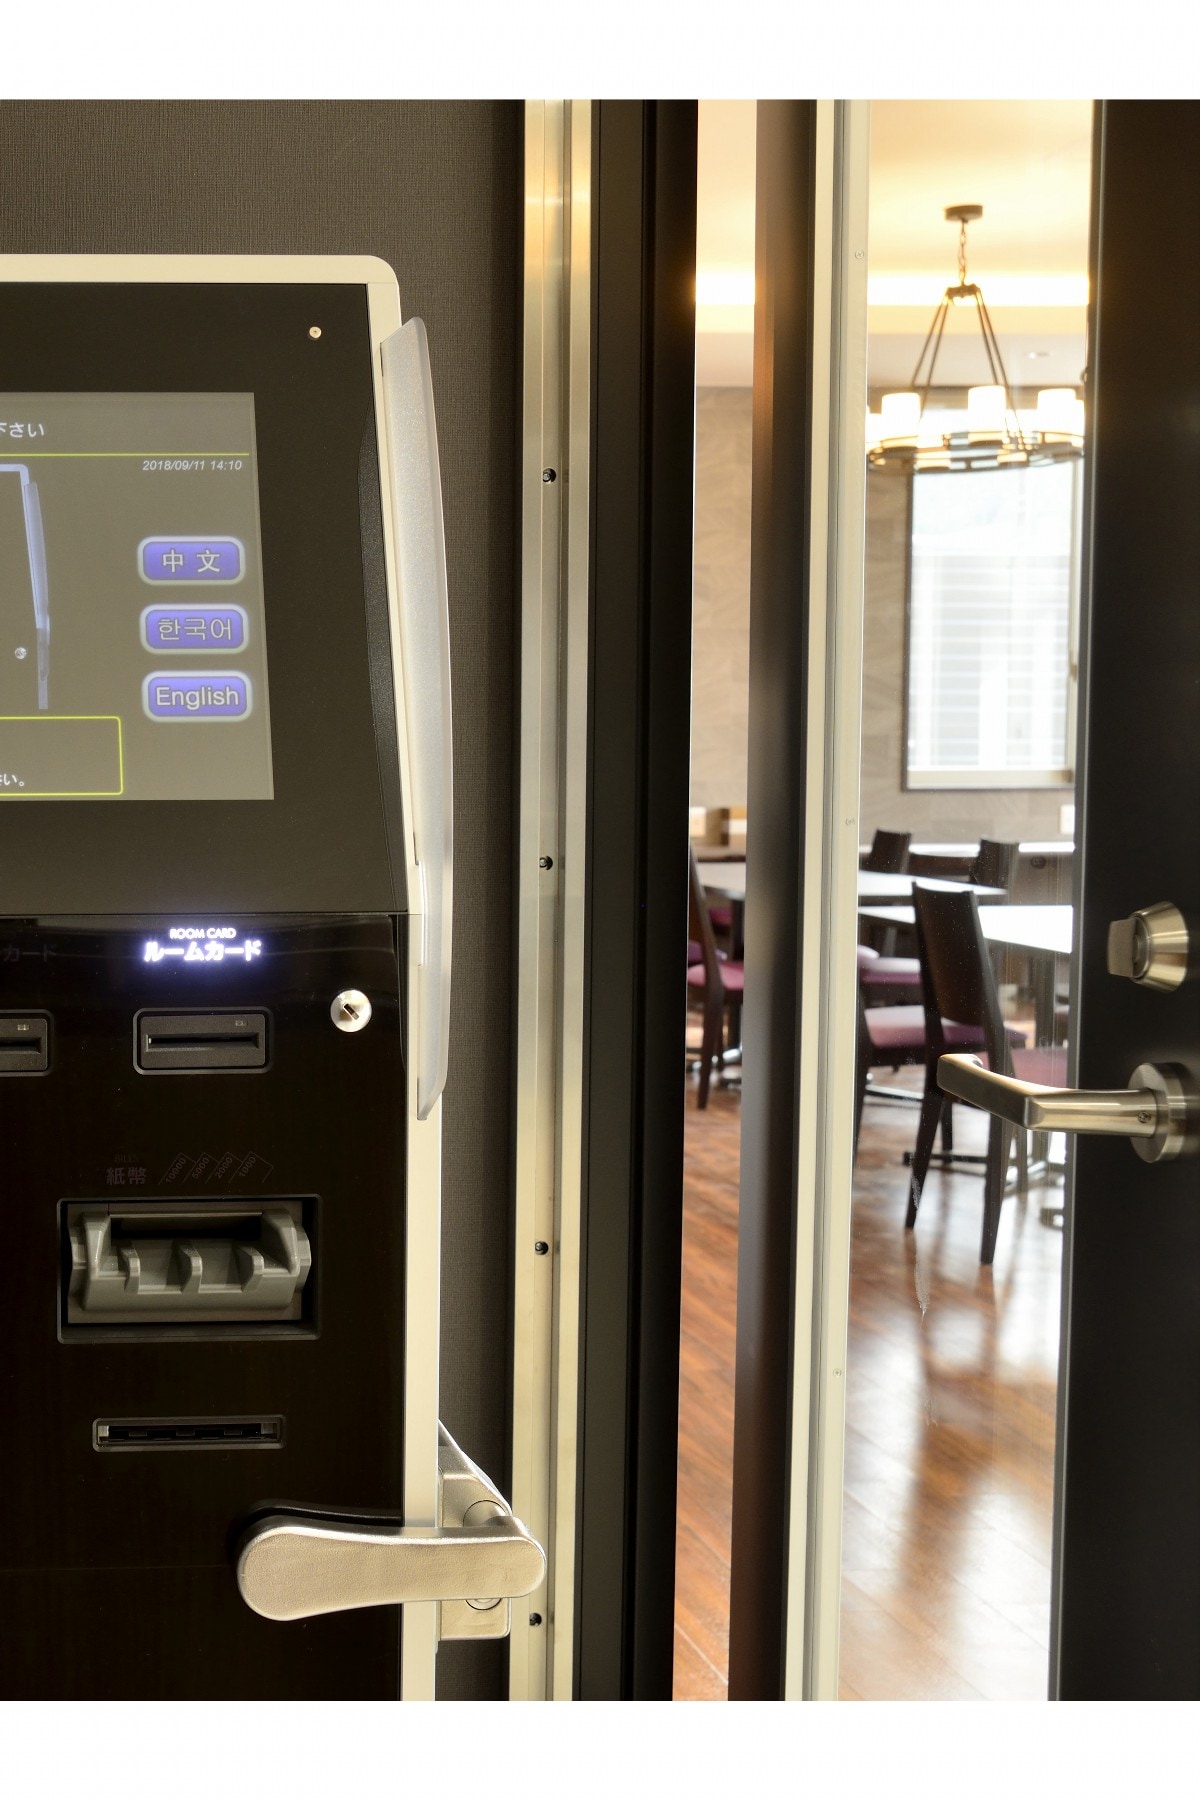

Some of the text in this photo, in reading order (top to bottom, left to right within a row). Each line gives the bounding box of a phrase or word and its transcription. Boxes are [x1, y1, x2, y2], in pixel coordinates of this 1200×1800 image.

[142, 459, 243, 472] 2018/09/11 14:10
[157, 617, 233, 641] 한국어
[156, 685, 239, 709] English
[169, 927, 237, 939] ROOM CARD
[143, 940, 262, 962] ルームカード
[105, 1166, 147, 1185] 紙幣
[165, 1156, 257, 1183] 10000 5000 2000 1000
